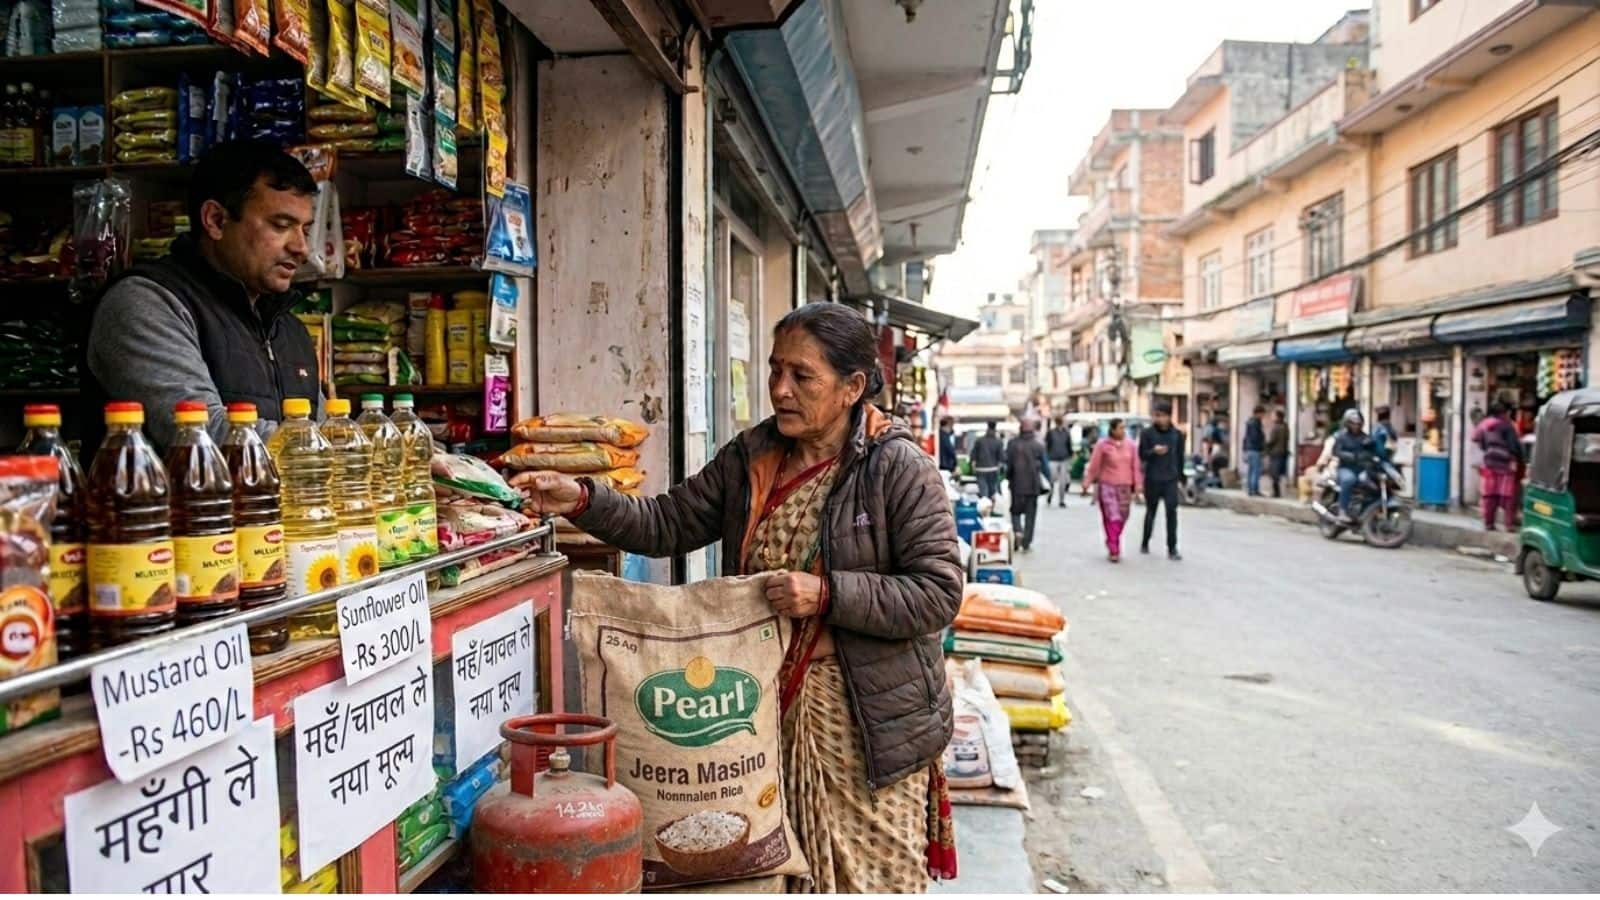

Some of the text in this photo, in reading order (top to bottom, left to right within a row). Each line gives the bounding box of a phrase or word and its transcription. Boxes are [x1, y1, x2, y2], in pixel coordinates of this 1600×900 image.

[341, 591, 406, 630] Sunflower
[380, 618, 425, 661] 300/L
[605, 635, 620, 647] 25
[102, 633, 244, 708] Mustard Oil
[172, 687, 246, 743] 460/L
[653, 679, 746, 719] Pearl
[224, 744, 259, 807] ले
[328, 759, 371, 805] नया
[629, 751, 766, 785] Jeera Masino
